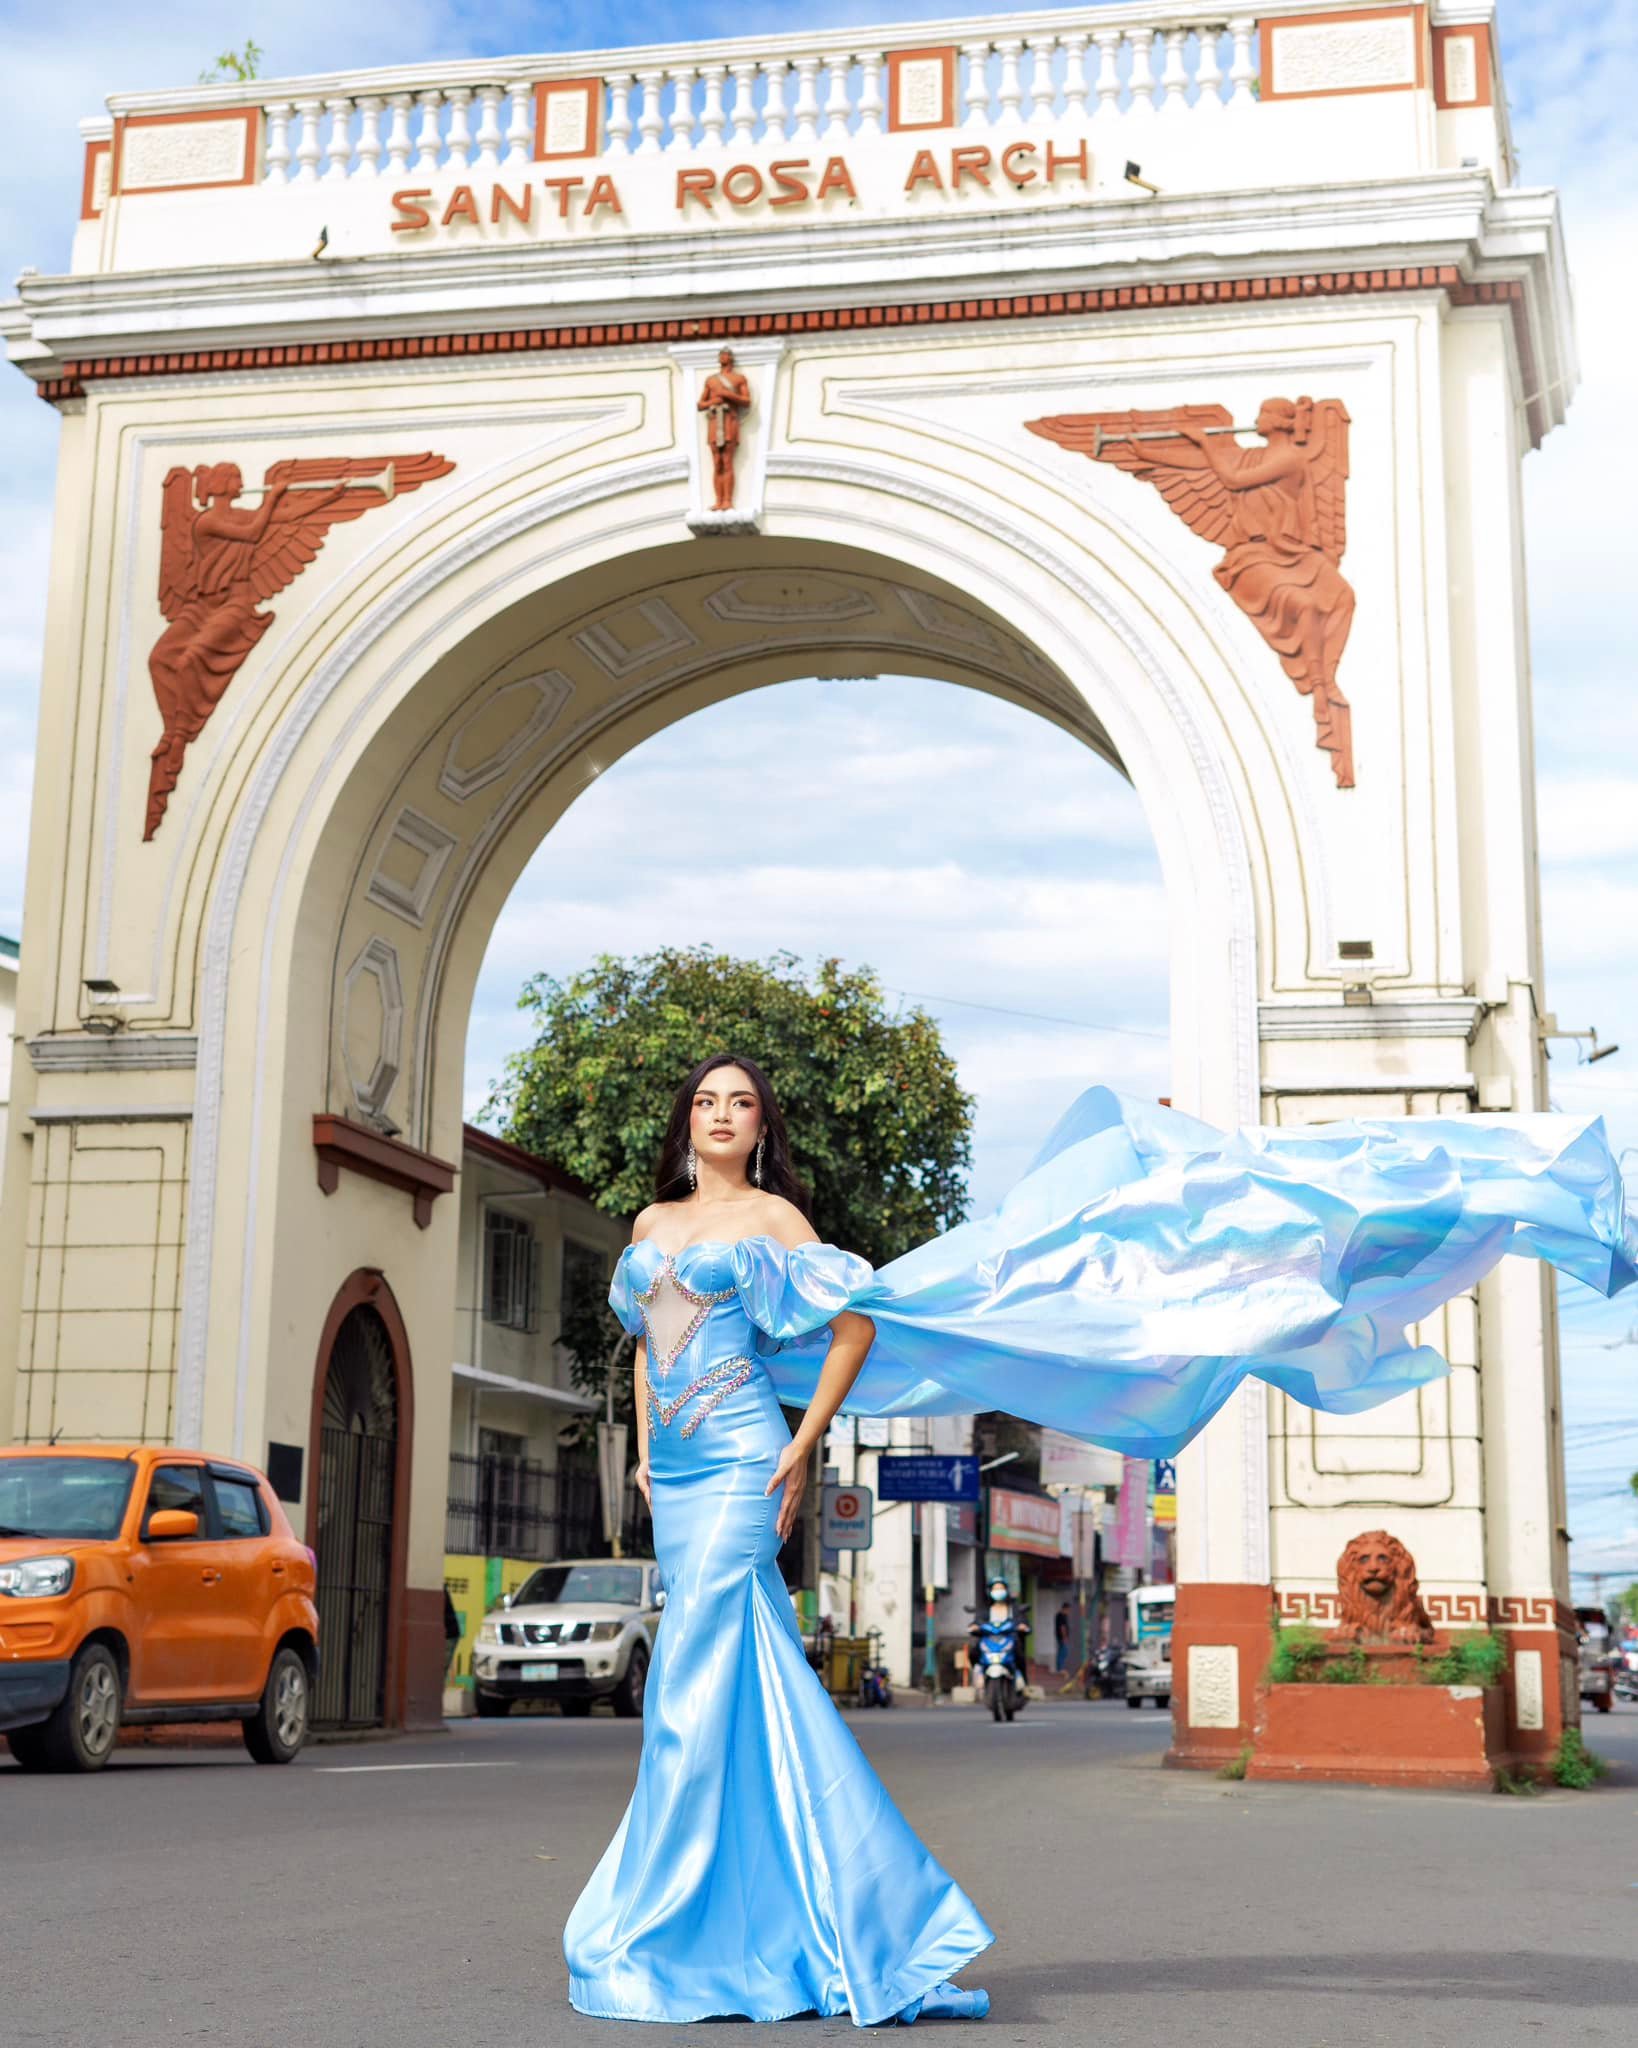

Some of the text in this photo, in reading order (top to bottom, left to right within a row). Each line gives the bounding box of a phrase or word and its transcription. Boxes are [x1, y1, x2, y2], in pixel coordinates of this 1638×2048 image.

[391, 138, 1089, 233] SANTA ROSA ARCH
